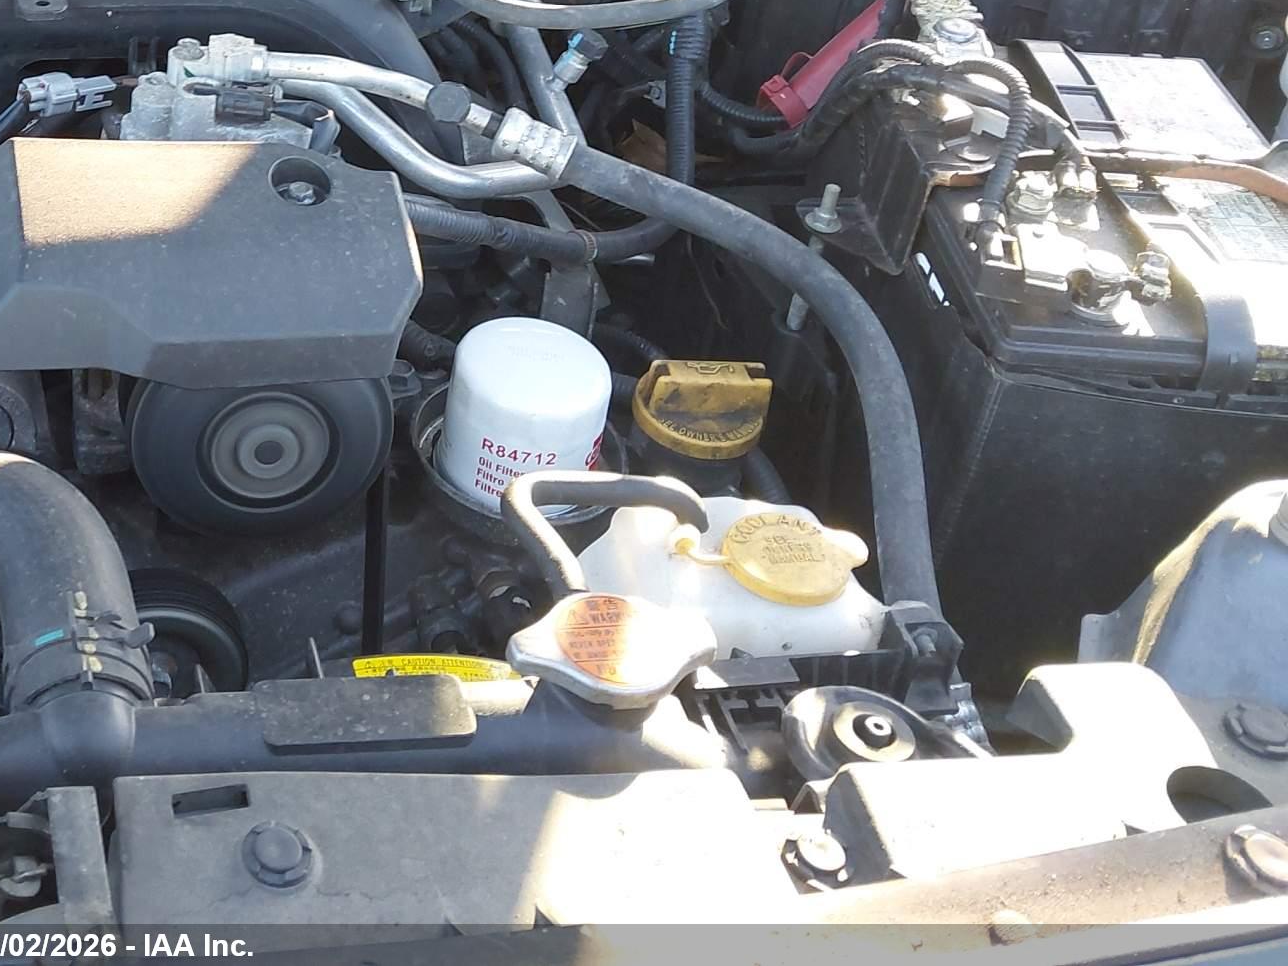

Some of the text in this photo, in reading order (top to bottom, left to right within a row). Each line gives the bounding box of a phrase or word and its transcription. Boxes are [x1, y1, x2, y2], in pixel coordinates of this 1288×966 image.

[481, 437, 557, 465] R84712
[478, 456, 492, 470] Oil
[476, 467, 505, 486] Filtro
[401, 658, 436, 667] CAUTION
